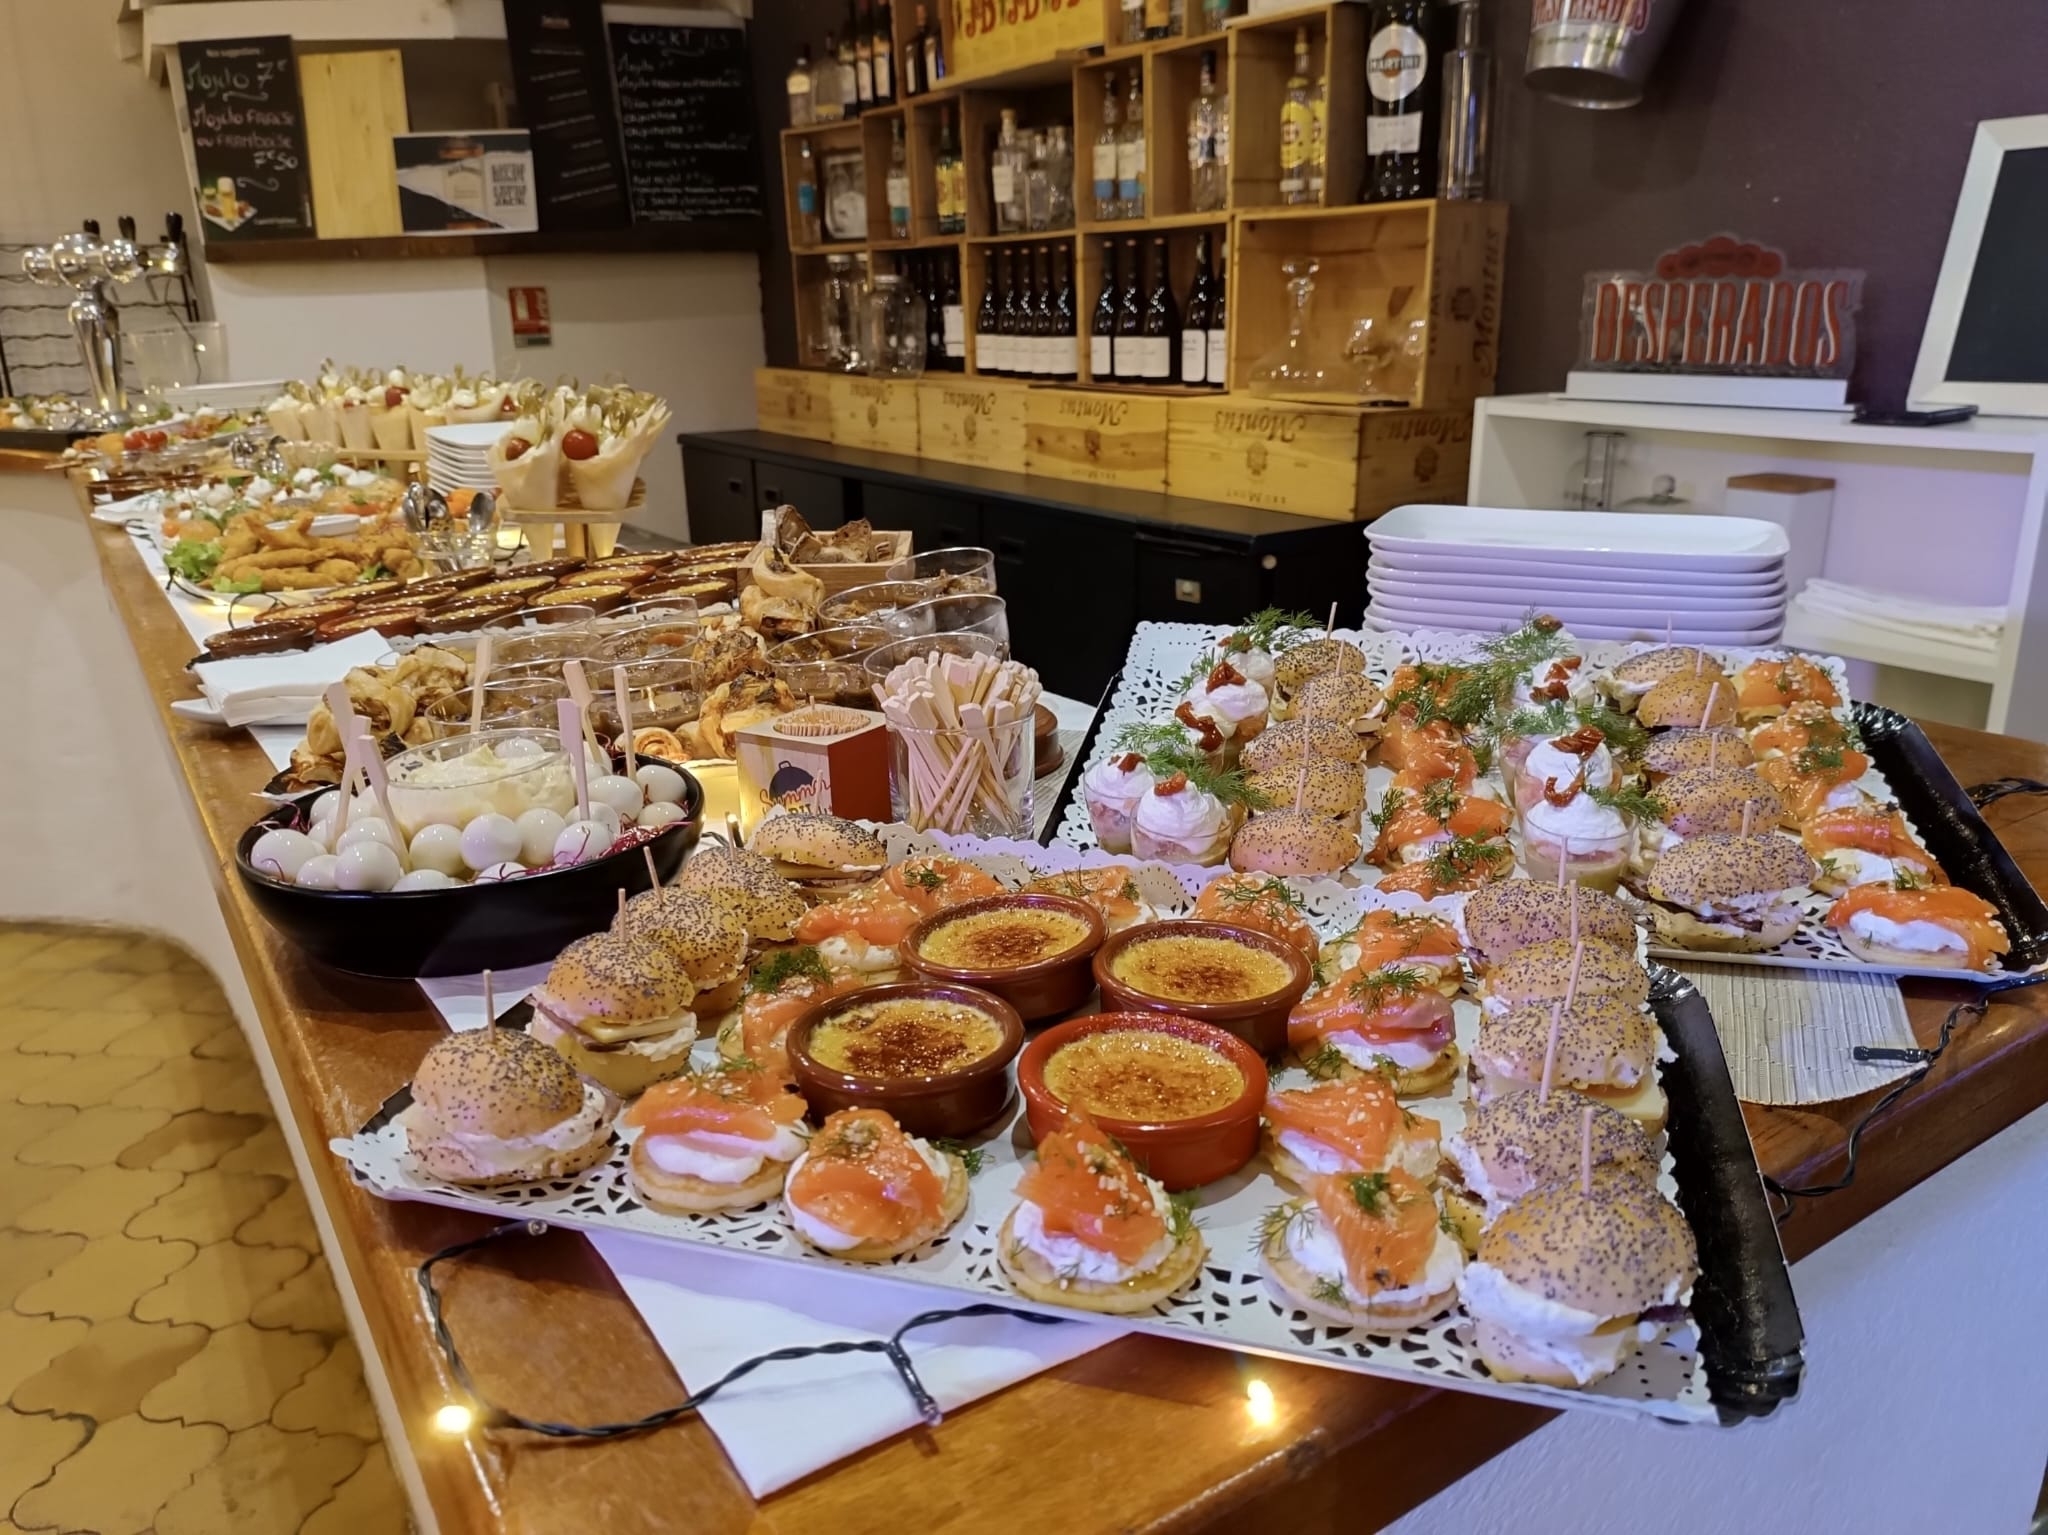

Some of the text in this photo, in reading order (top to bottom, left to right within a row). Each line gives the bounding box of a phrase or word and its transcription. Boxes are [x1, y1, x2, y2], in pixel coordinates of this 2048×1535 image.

[1368, 54, 1422, 74] MARTINI
[1590, 281, 1848, 367] DESPERADOS
[942, 390, 997, 416] Montus
[1058, 399, 1129, 427] Montus
[1213, 410, 1306, 444] Montus
